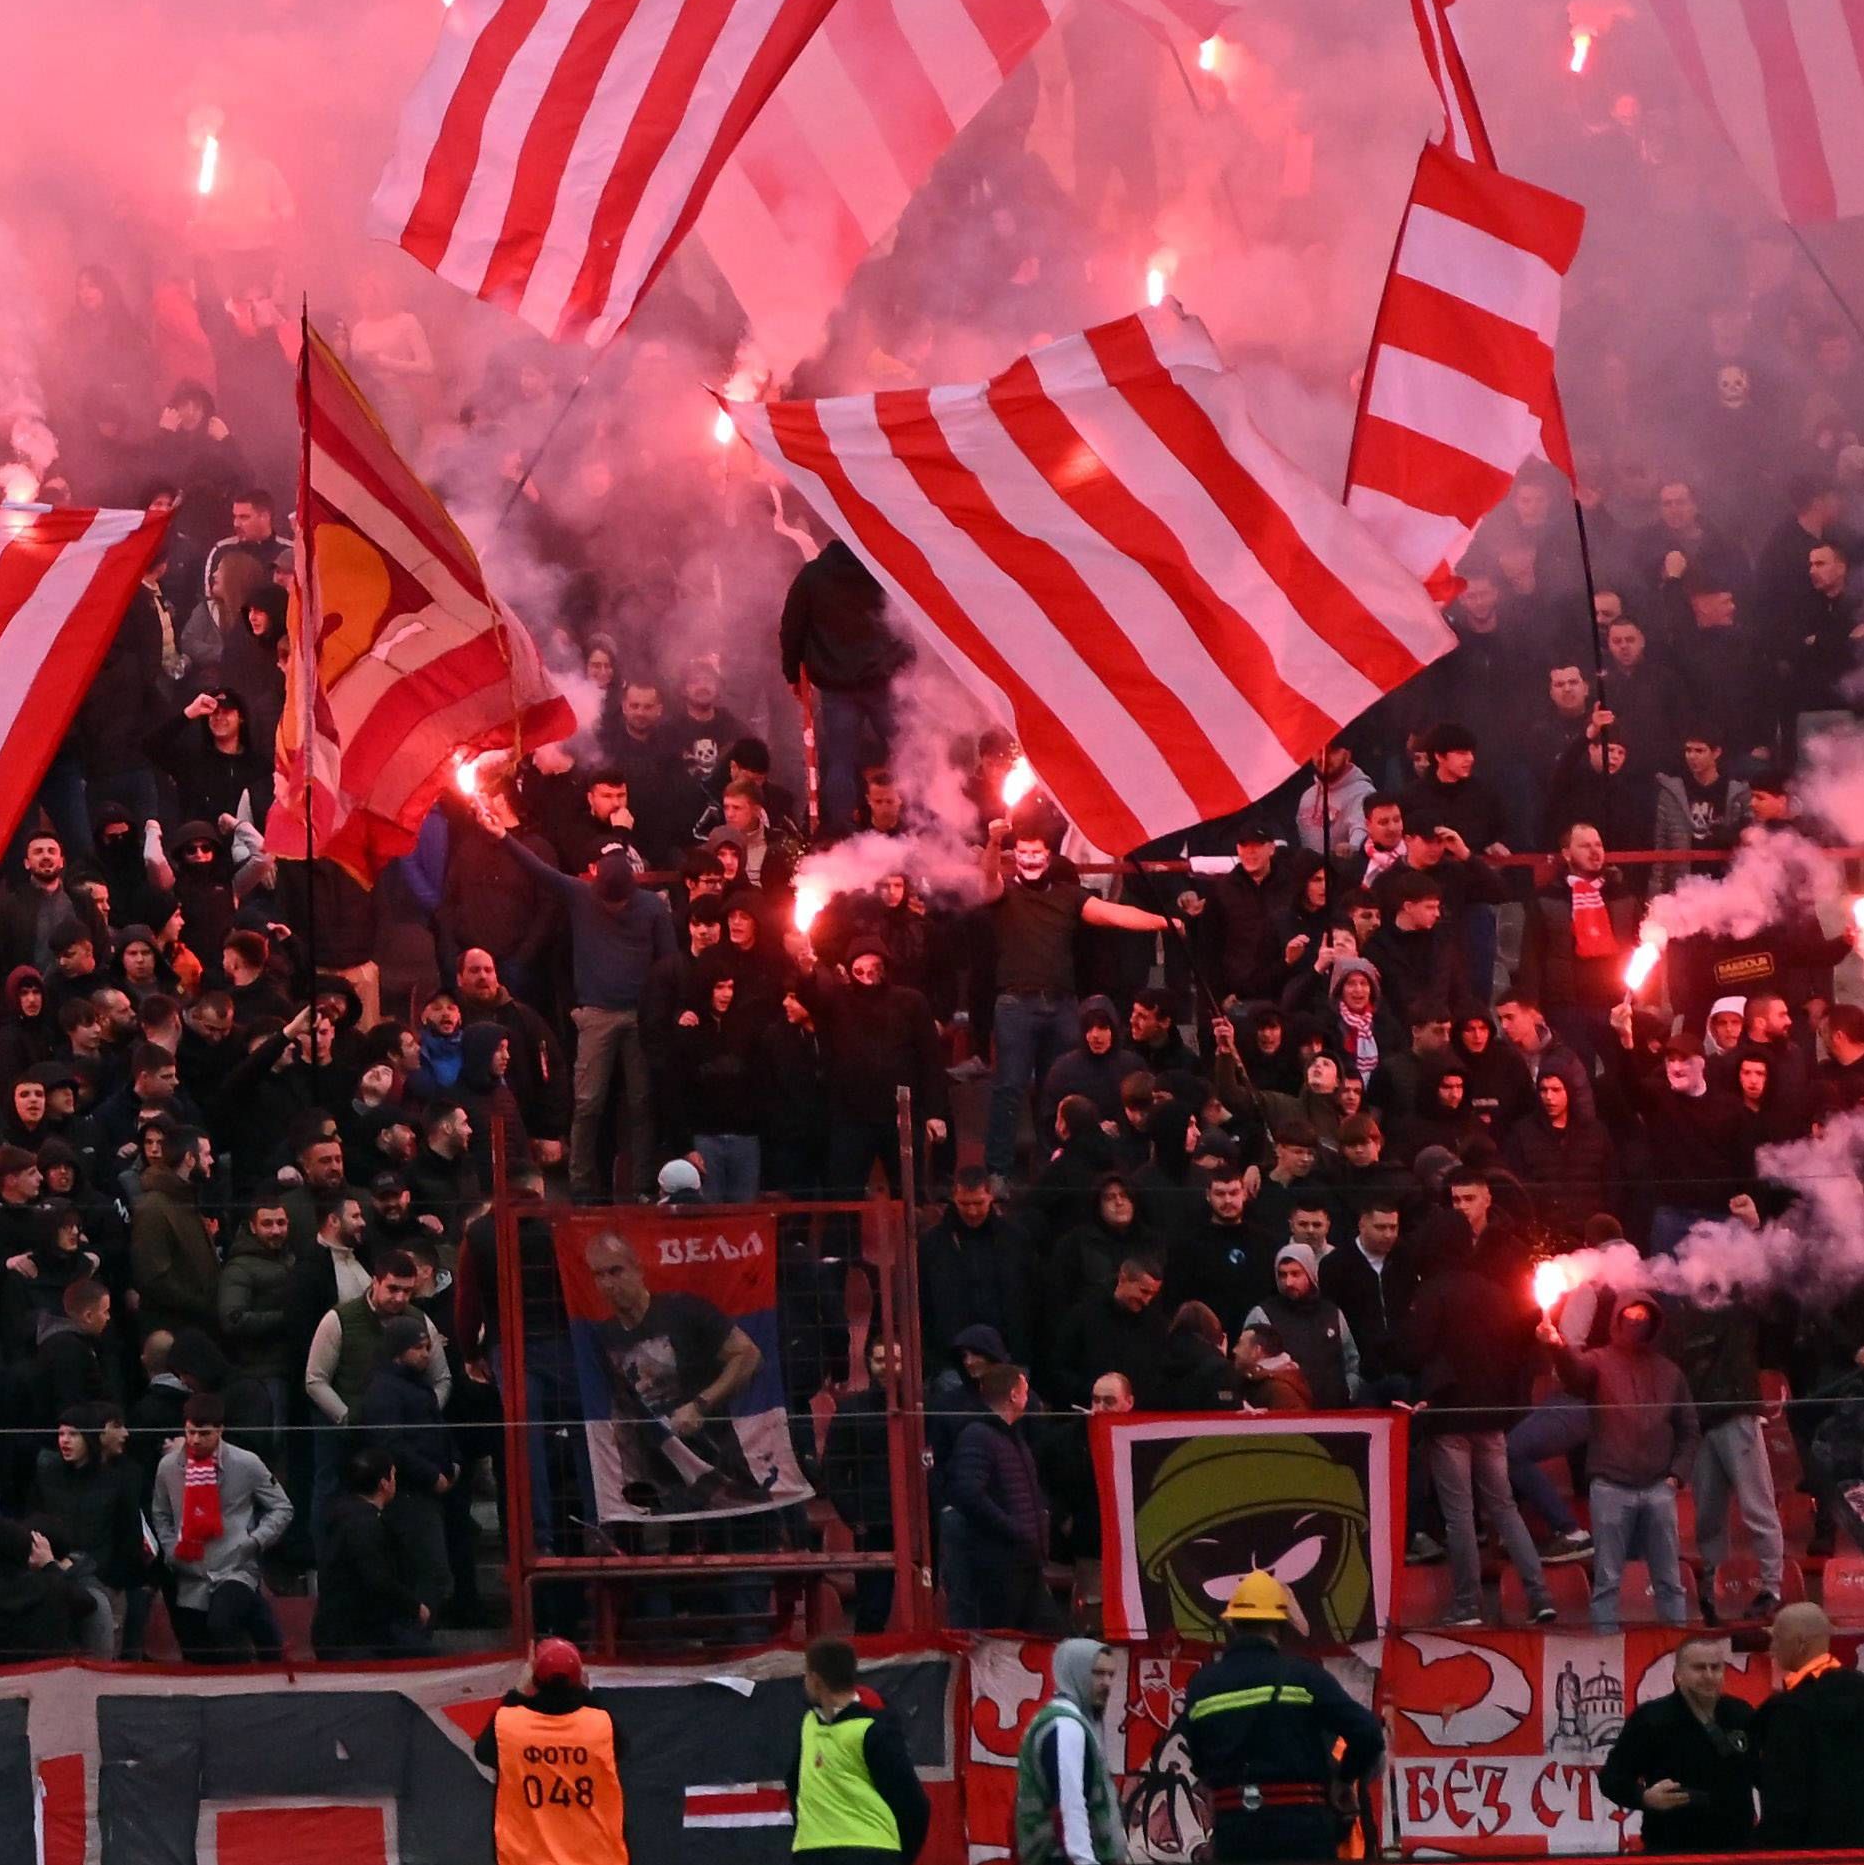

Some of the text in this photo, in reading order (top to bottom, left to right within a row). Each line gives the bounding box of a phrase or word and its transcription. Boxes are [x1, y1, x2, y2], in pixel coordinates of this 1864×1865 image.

[656, 1231, 764, 1265] ВЕЉА
[523, 1745, 588, 1765] ФОТО
[523, 1774, 594, 1809] 048
[1404, 1758, 1513, 1839] БЕЗ
